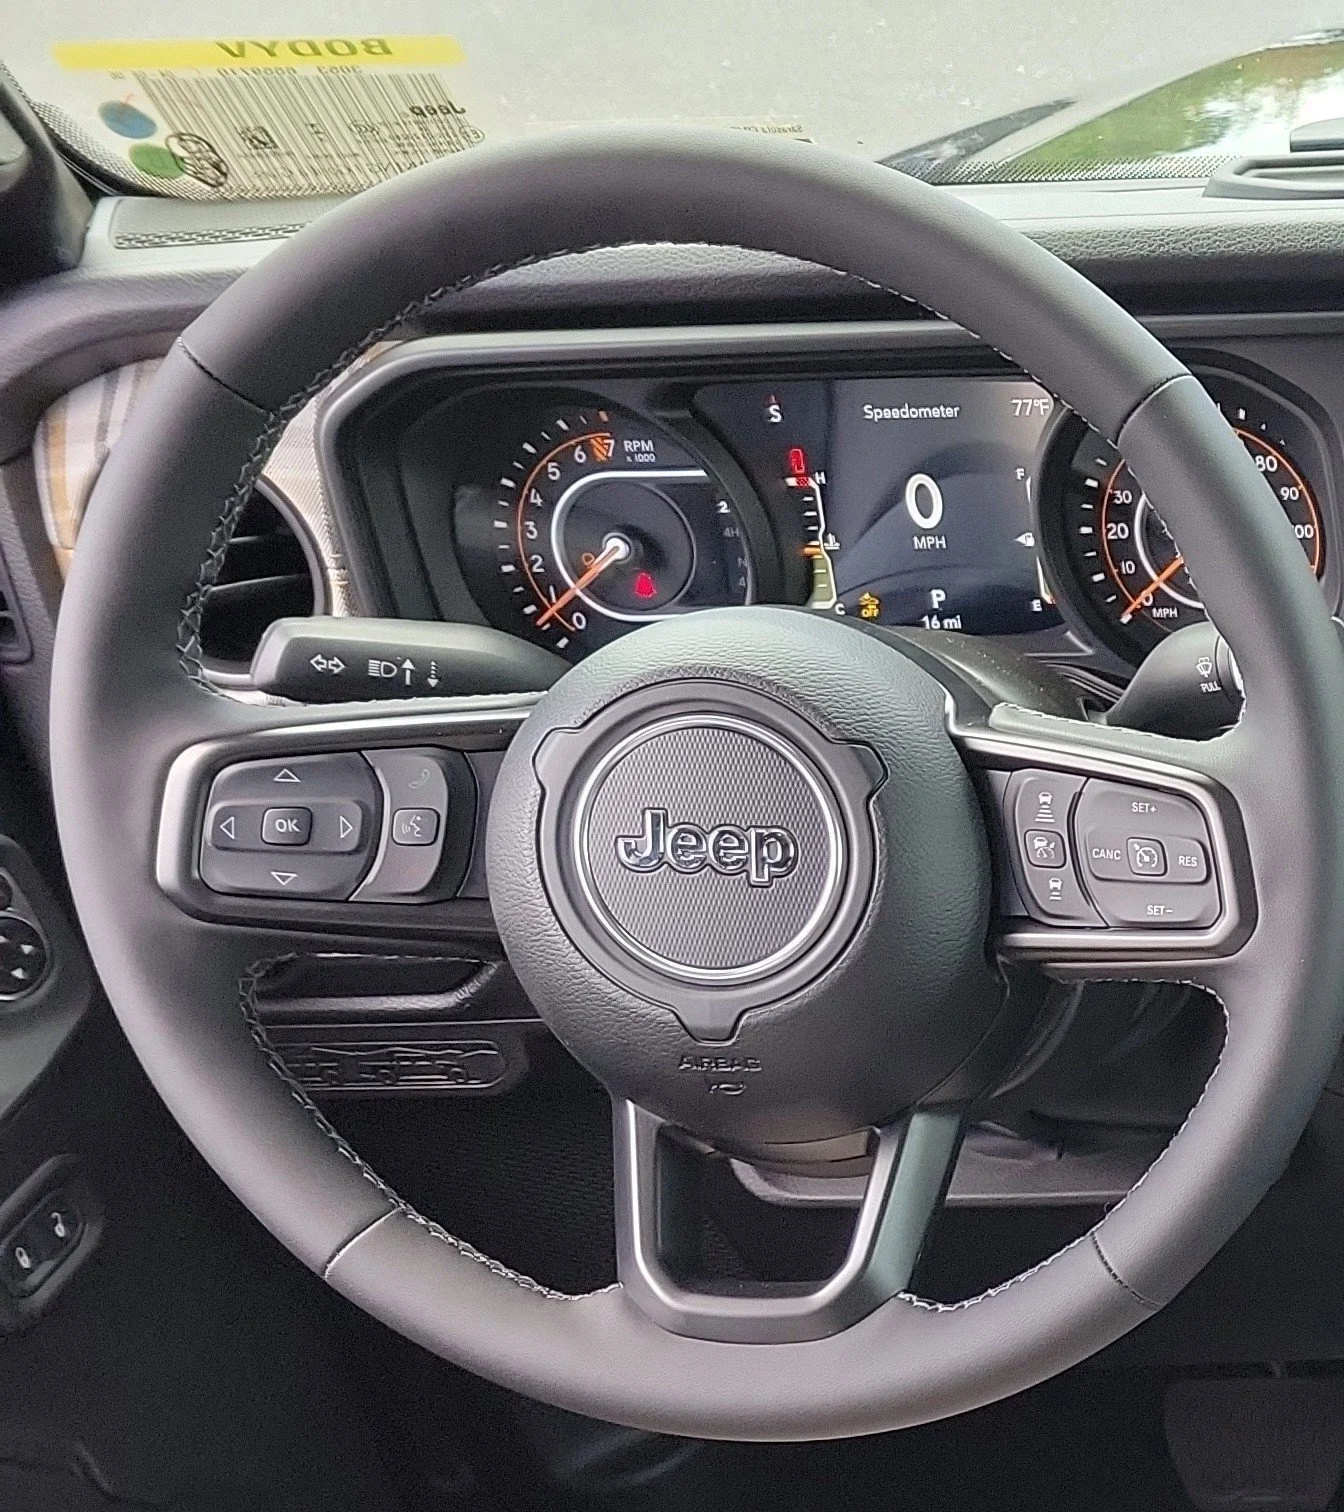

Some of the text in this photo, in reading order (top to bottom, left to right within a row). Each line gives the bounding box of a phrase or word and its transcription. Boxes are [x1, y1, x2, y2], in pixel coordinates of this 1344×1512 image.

[768, 405, 783, 423] S
[863, 403, 960, 422] Speedometer
[1011, 398, 1050, 417] 77°F
[603, 439, 615, 457] 7
[624, 440, 654, 452] RPM
[574, 445, 587, 463] 6
[1256, 455, 1278, 472] 80
[547, 463, 561, 480] 5
[815, 472, 826, 485] H
[1015, 468, 1025, 480] F
[530, 488, 543, 506] 4
[905, 473, 943, 529] 0
[1114, 490, 1133, 504] 30
[1281, 486, 1299, 501] 90
[526, 521, 538, 540] 3
[1107, 523, 1129, 540] 20
[1292, 524, 1314, 539] 00
[913, 535, 947, 549] MPH
[531, 555, 544, 572] 2
[1121, 561, 1136, 575] 10
[930, 589, 946, 610] P
[1031, 600, 1042, 612] E
[835, 604, 846, 615] C
[1152, 608, 1178, 618] MPH
[572, 612, 586, 629] 0
[922, 615, 961, 629] 16 mi
[1201, 682, 1221, 692] PULL
[275, 819, 300, 833] OK
[615, 808, 799, 887] Jeep
[1093, 849, 1121, 860] CANC
[1178, 855, 1198, 867] RES
